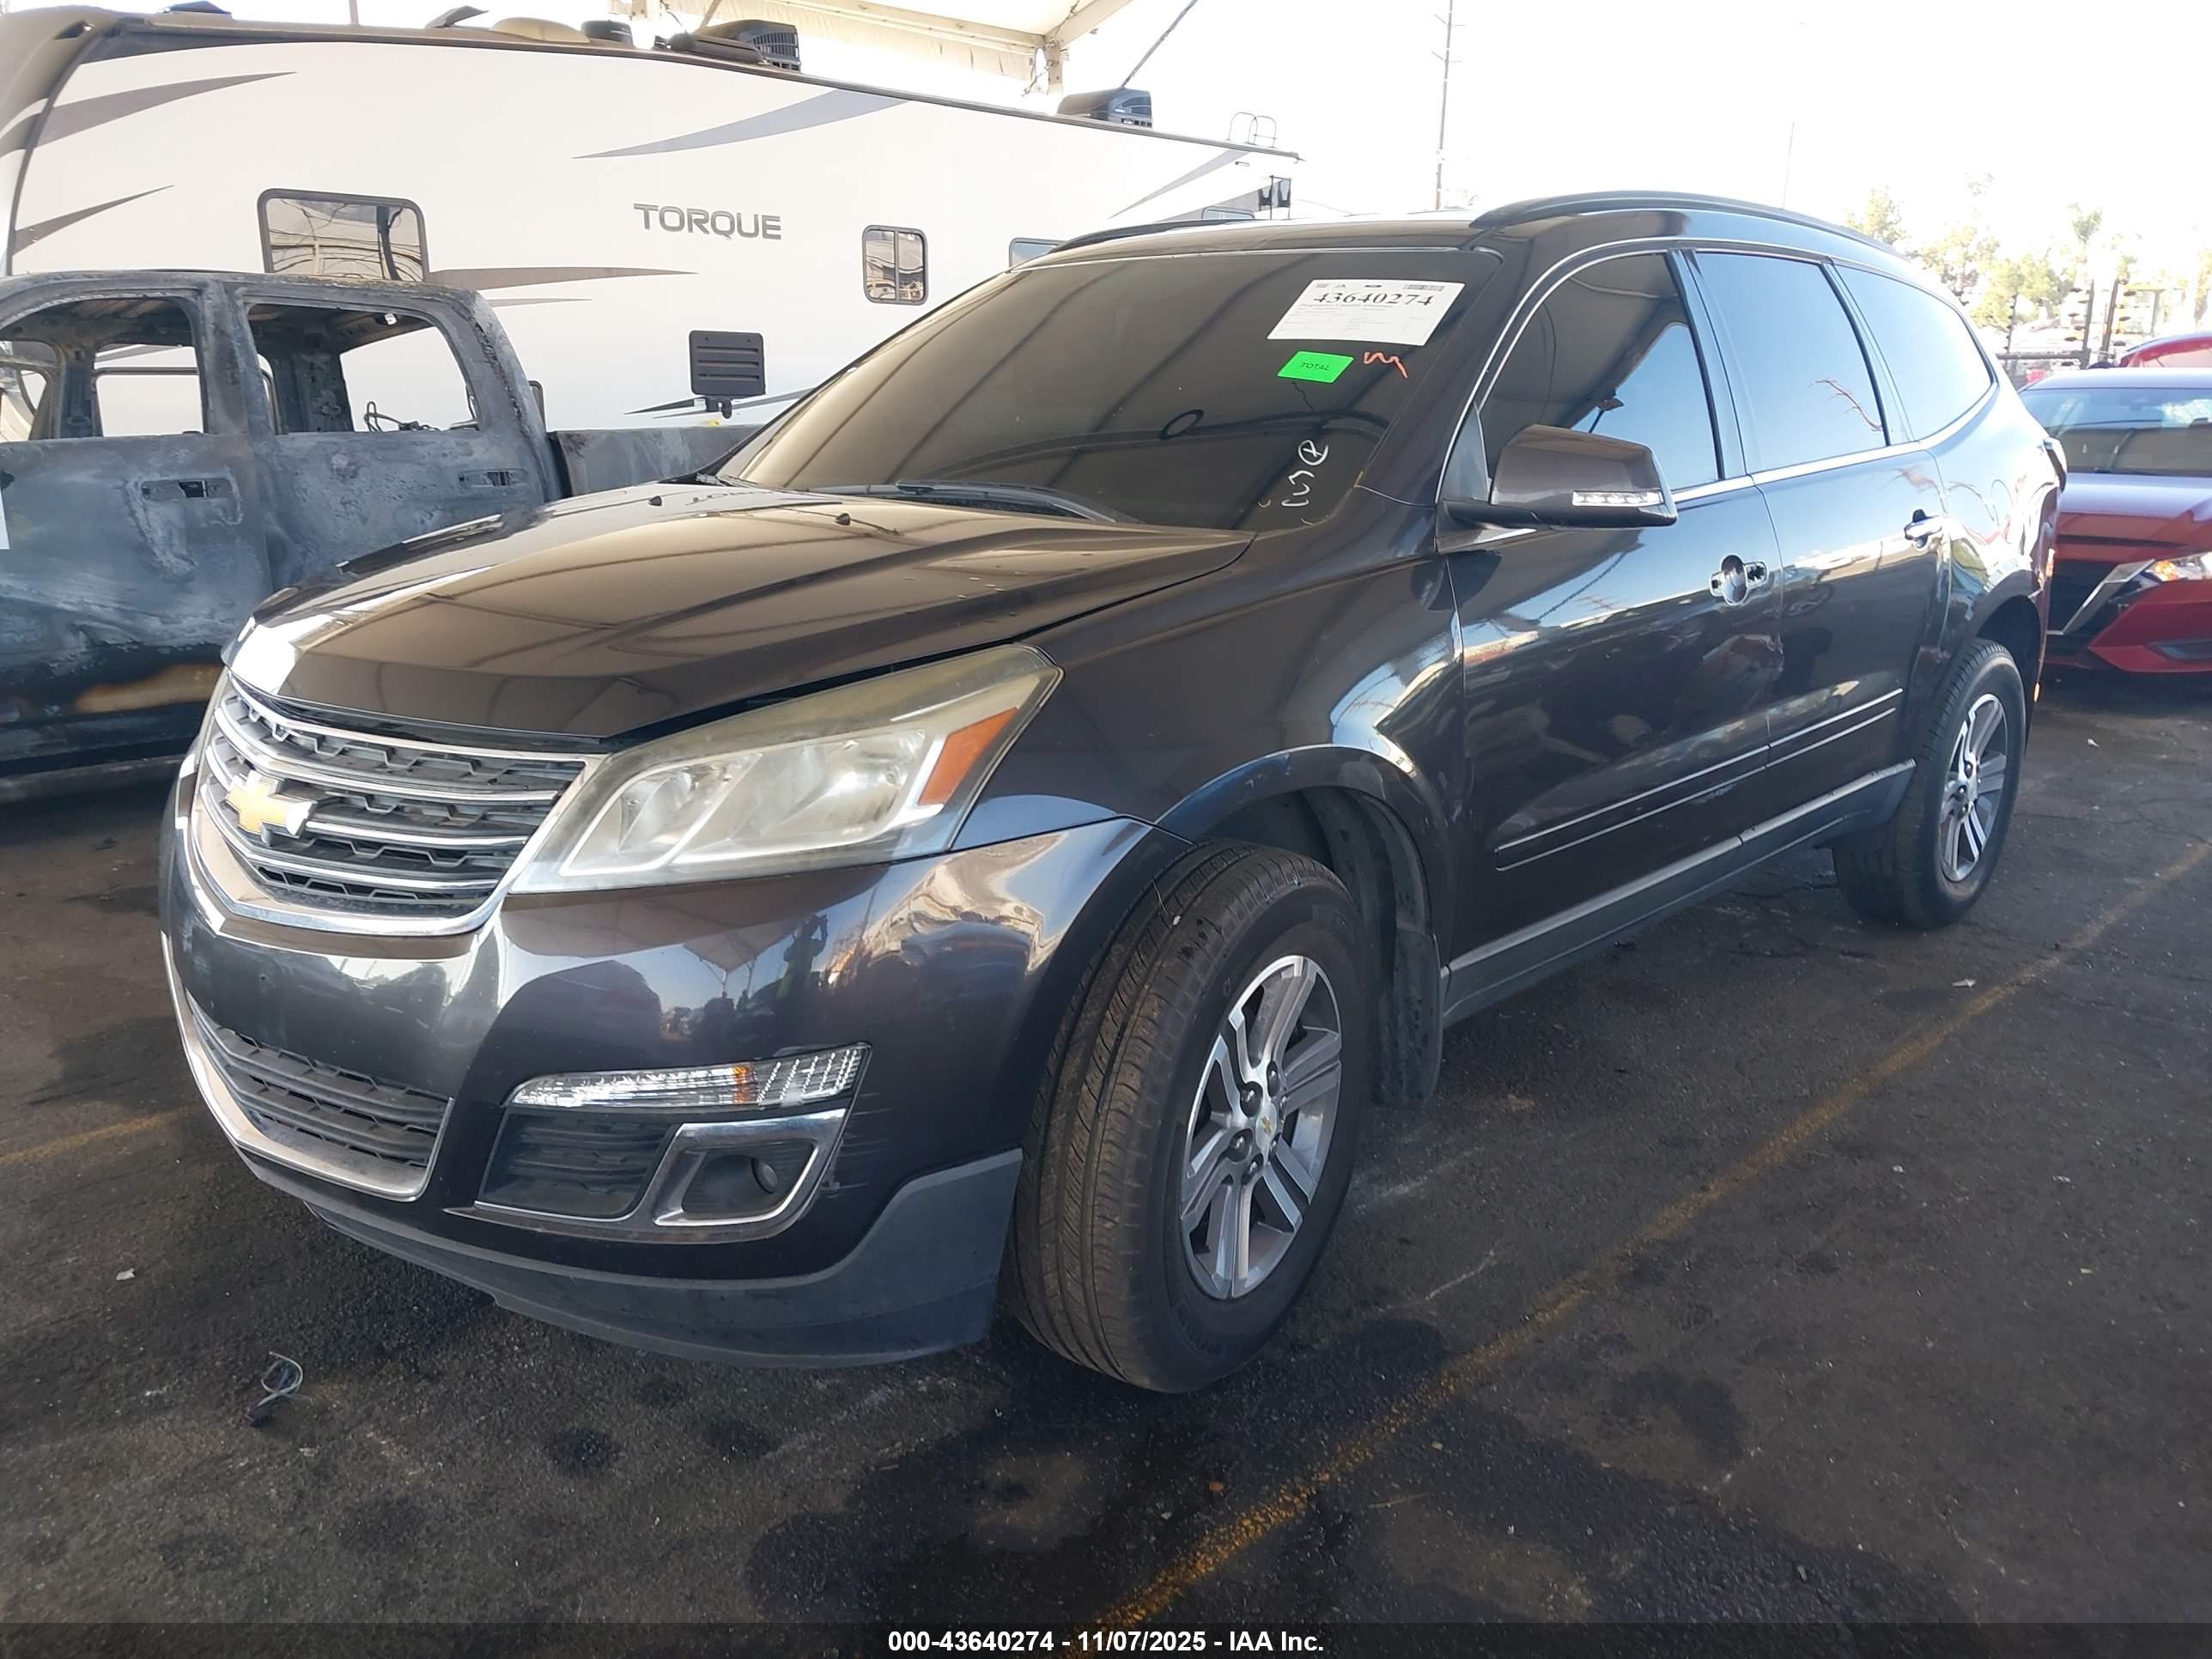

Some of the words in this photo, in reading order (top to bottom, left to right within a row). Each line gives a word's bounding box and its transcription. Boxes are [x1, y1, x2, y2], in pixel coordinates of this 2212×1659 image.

[633, 203, 782, 240] TORQUE
[1313, 291, 1435, 307] 43640274
[1300, 361, 1333, 372] TOTAL
